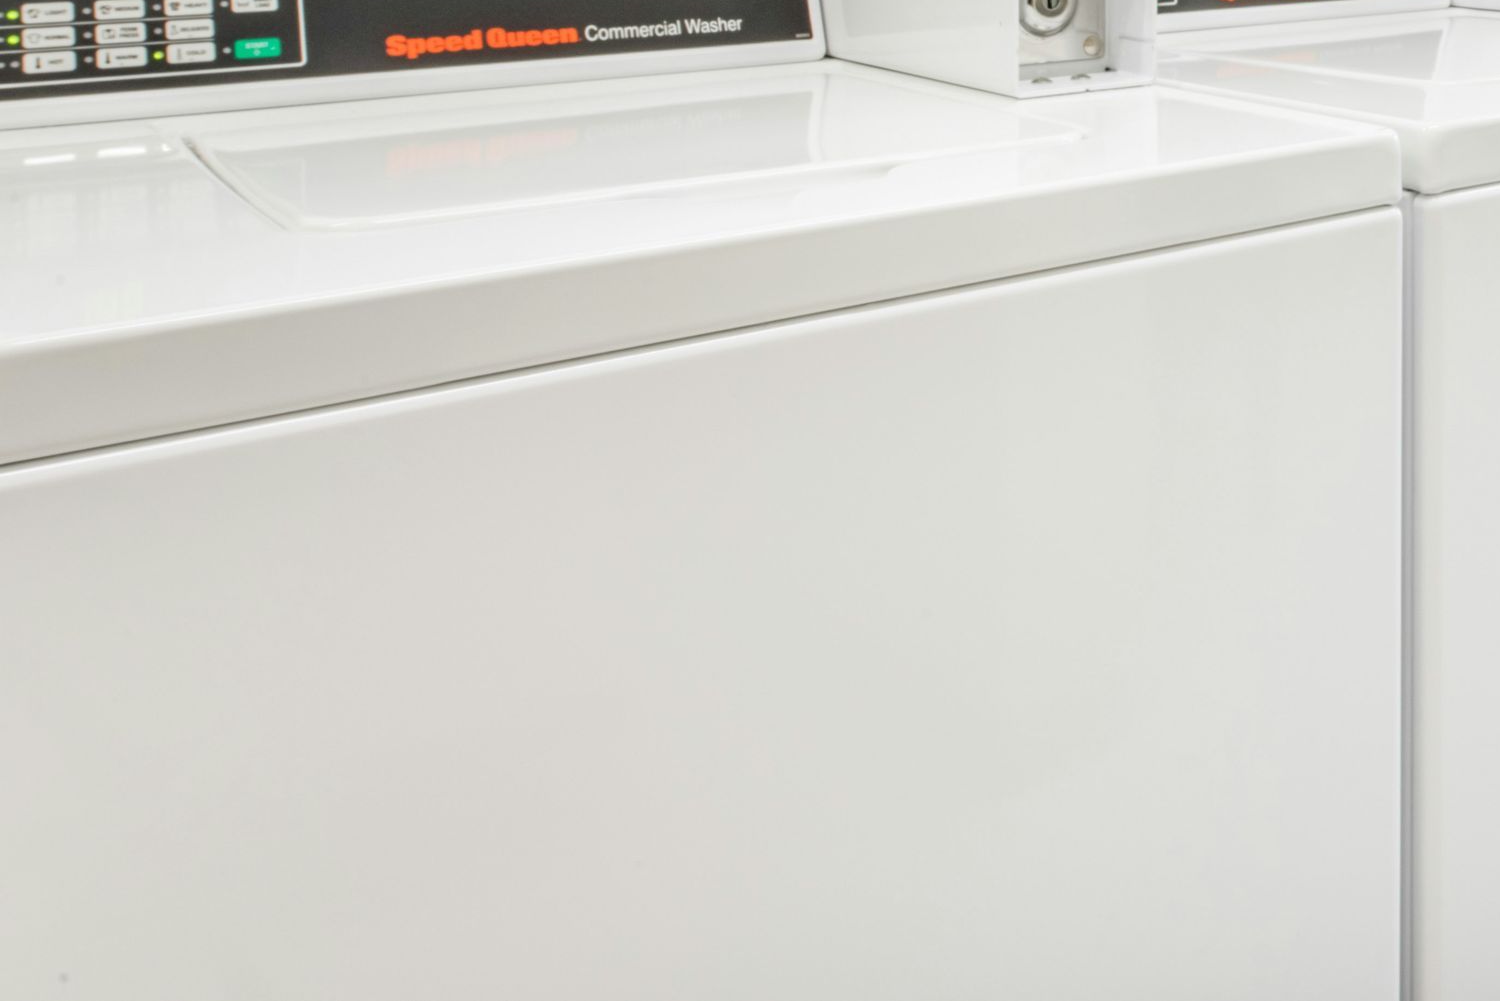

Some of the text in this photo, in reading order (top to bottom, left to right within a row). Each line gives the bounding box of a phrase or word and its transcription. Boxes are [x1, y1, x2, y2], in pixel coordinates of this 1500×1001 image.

[385, 16, 742, 60] Speed Queen Commercial Washer
